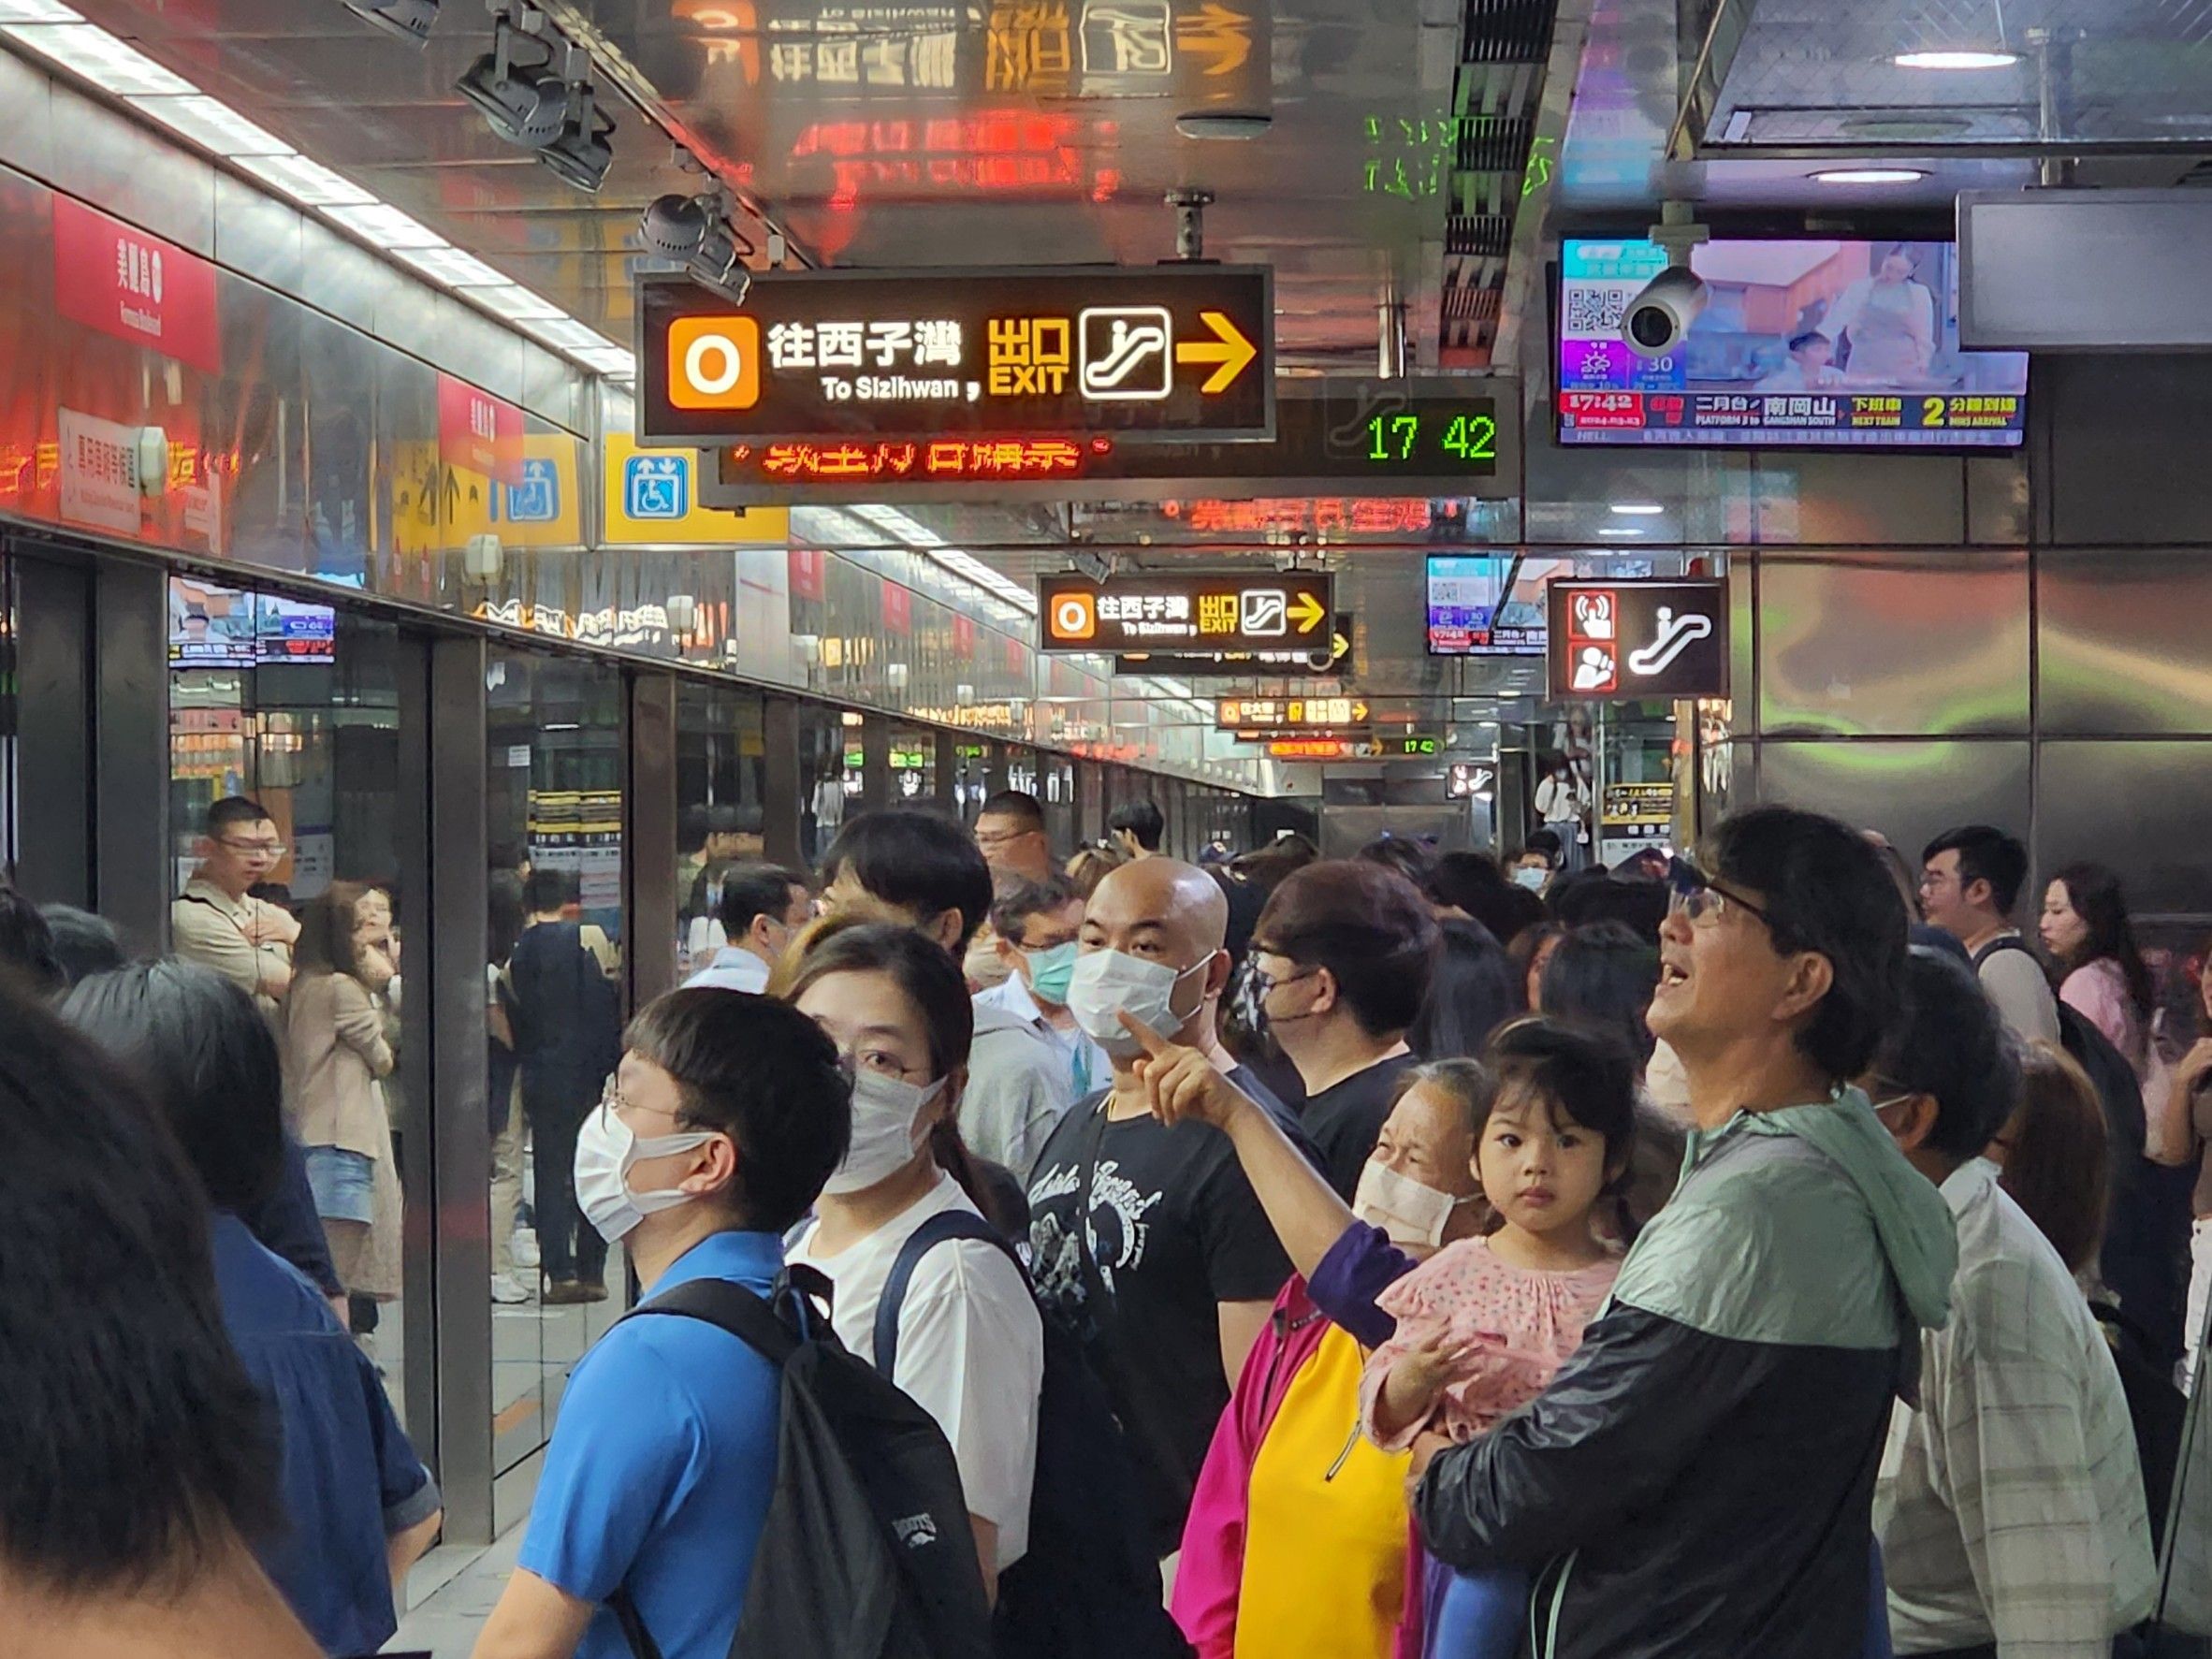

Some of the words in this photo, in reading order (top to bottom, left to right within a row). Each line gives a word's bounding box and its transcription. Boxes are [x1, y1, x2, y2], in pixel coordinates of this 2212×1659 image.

[767, 321, 962, 369] 往西子灣
[989, 319, 1070, 366] 出口
[685, 334, 741, 395] O
[821, 375, 852, 400] To
[989, 366, 1070, 395] EXIT
[1568, 394, 1633, 412] 17:42
[1921, 397, 1945, 428] 2
[1369, 416, 1419, 459] 17
[1444, 416, 1495, 459] 42
[1058, 601, 1086, 633] O
[1199, 595, 1238, 618] 出口
[1200, 618, 1237, 633] EXIT
